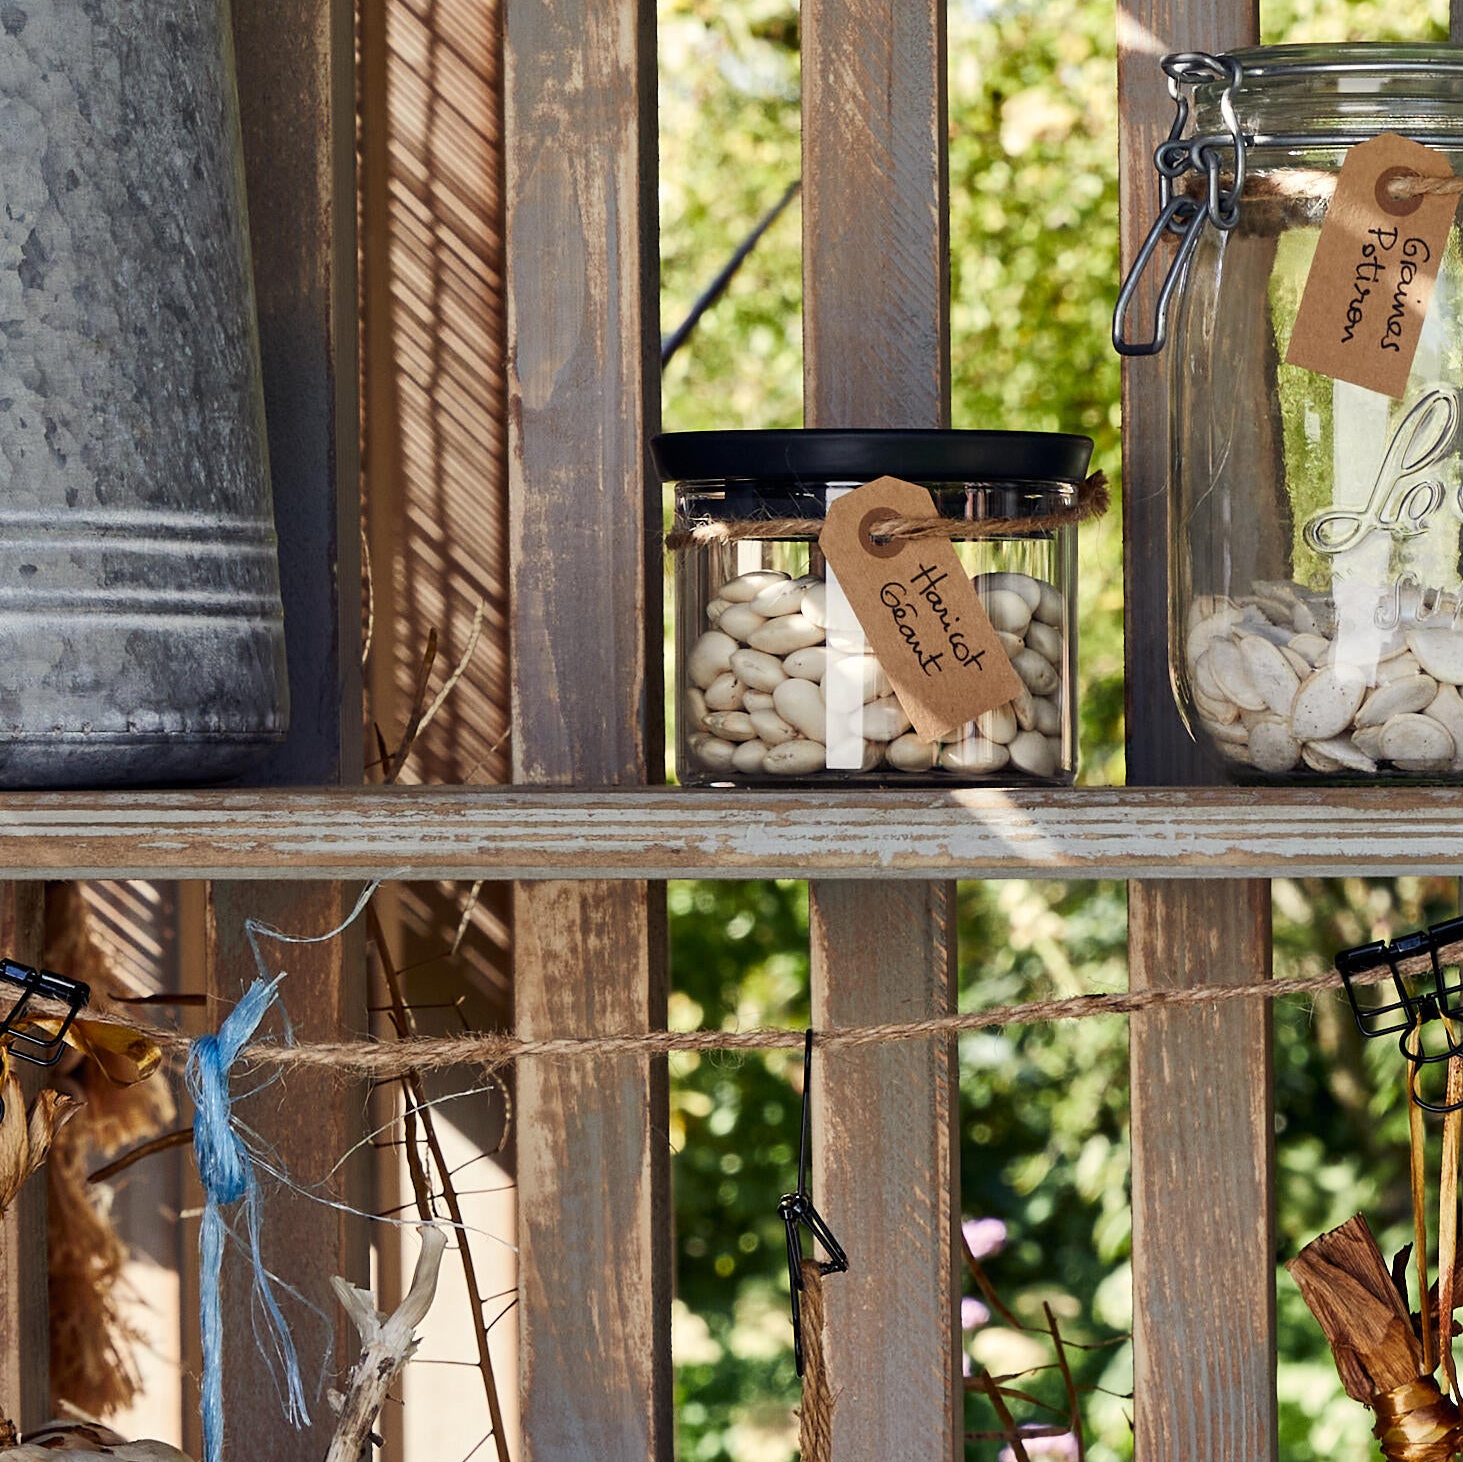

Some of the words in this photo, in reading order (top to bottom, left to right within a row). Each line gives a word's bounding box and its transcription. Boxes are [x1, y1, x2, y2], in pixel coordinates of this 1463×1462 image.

[1341, 227, 1398, 344] Potiron
[1380, 237, 1430, 353] Graines
[880, 582, 943, 677] Géant
[911, 563, 986, 671] Haricot
